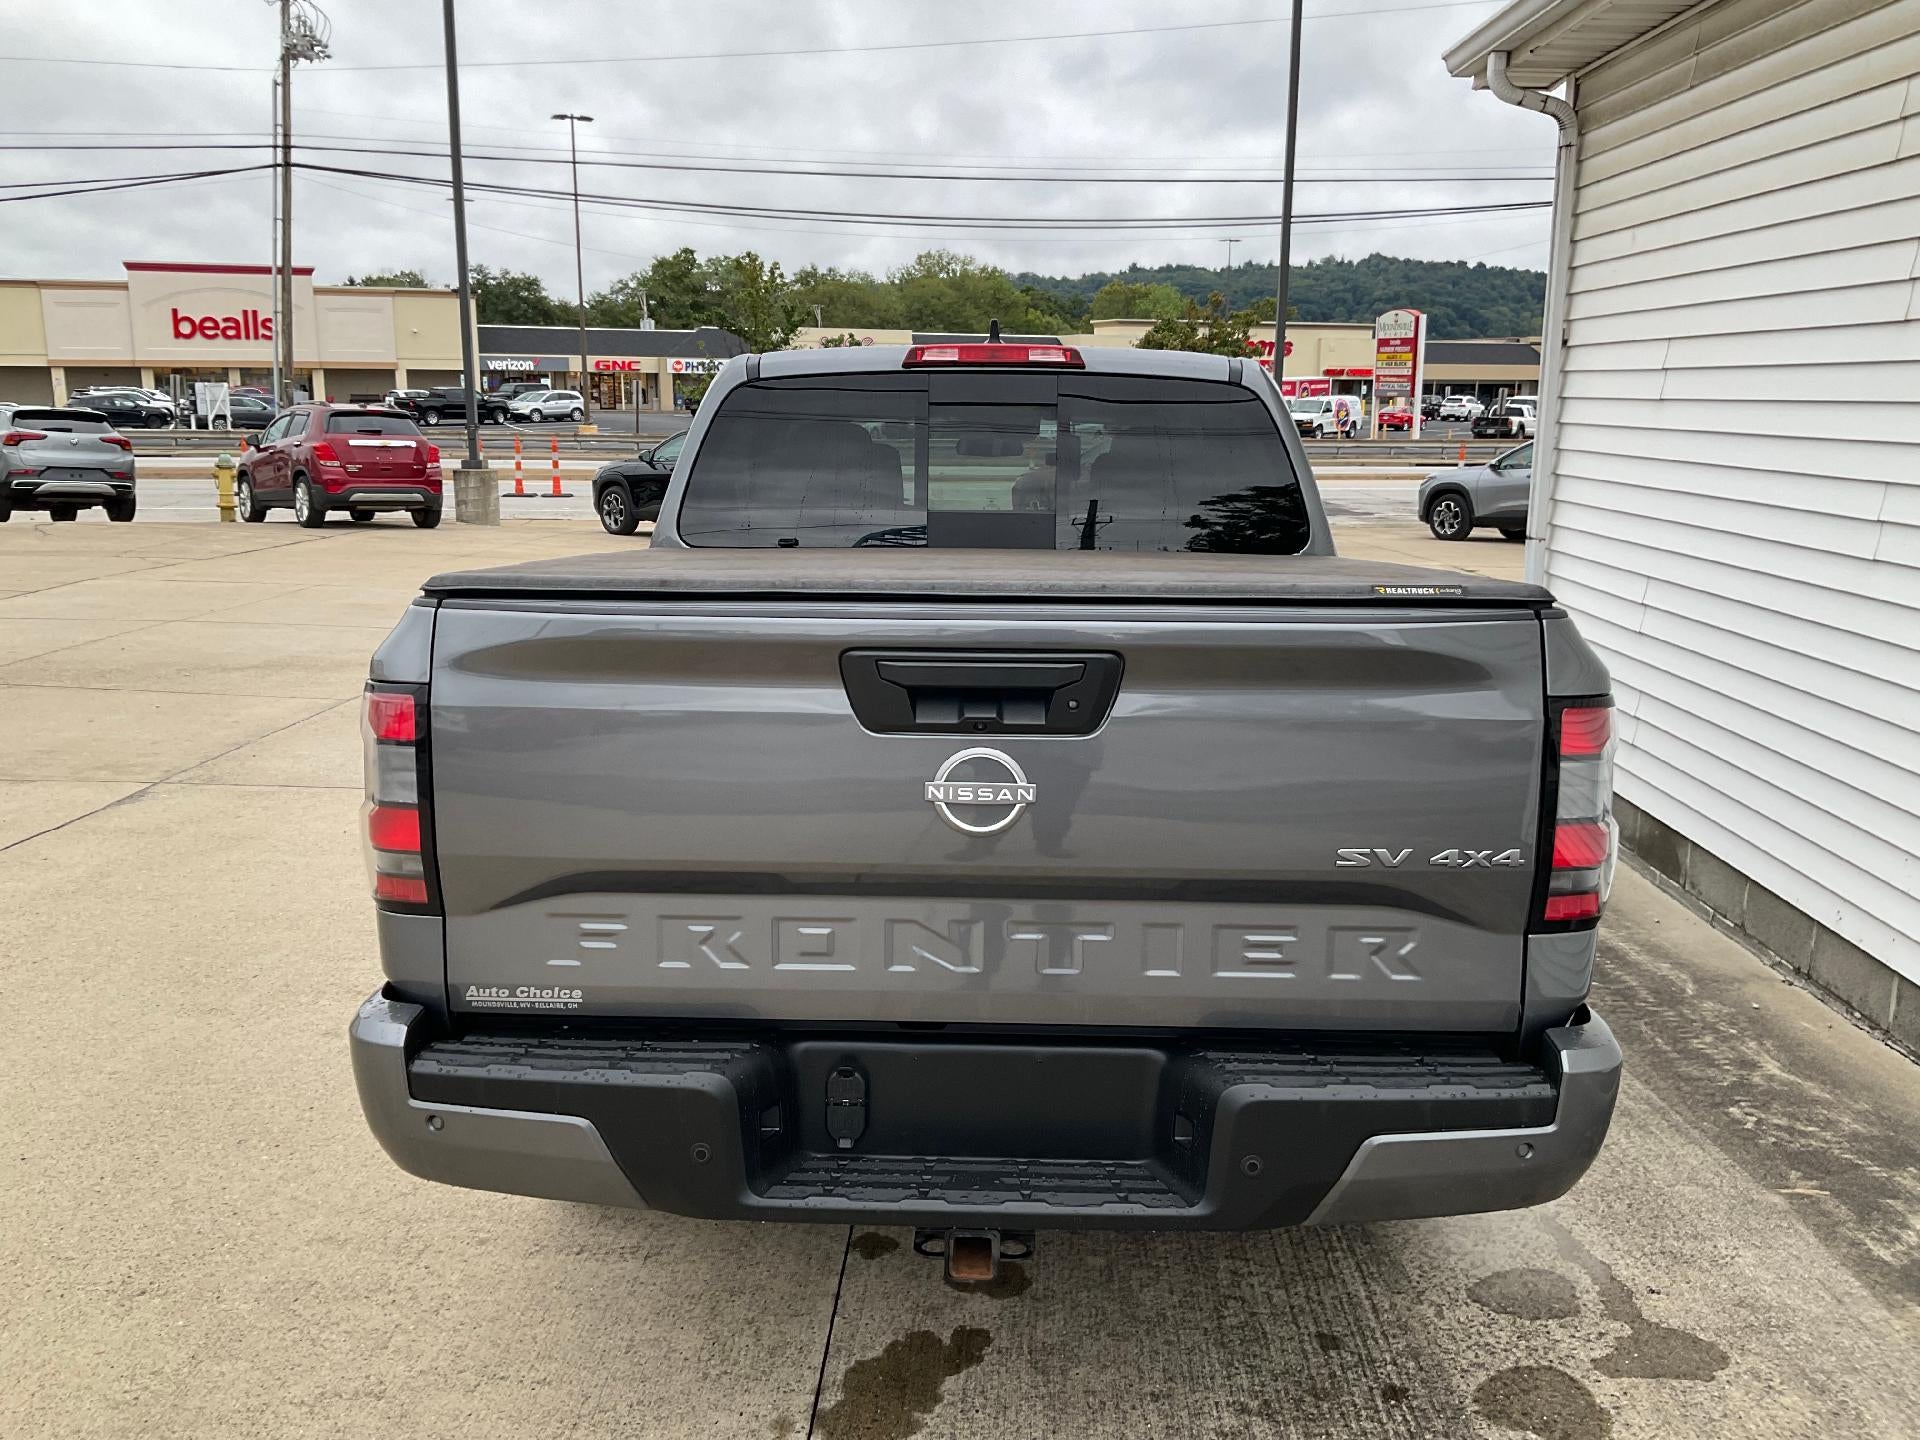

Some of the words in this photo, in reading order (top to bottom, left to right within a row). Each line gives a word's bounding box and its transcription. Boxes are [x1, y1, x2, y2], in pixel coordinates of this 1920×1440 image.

[171, 308, 273, 341] bealls
[487, 358, 534, 371] verizon
[594, 360, 641, 371] GNC
[1386, 587, 1435, 595] REALTRUCK
[927, 785, 1034, 802] NISSAN
[1335, 847, 1414, 868] SV
[545, 911, 1423, 982] FRONTIER
[466, 985, 510, 998] Auto
[515, 986, 583, 999] Choice
